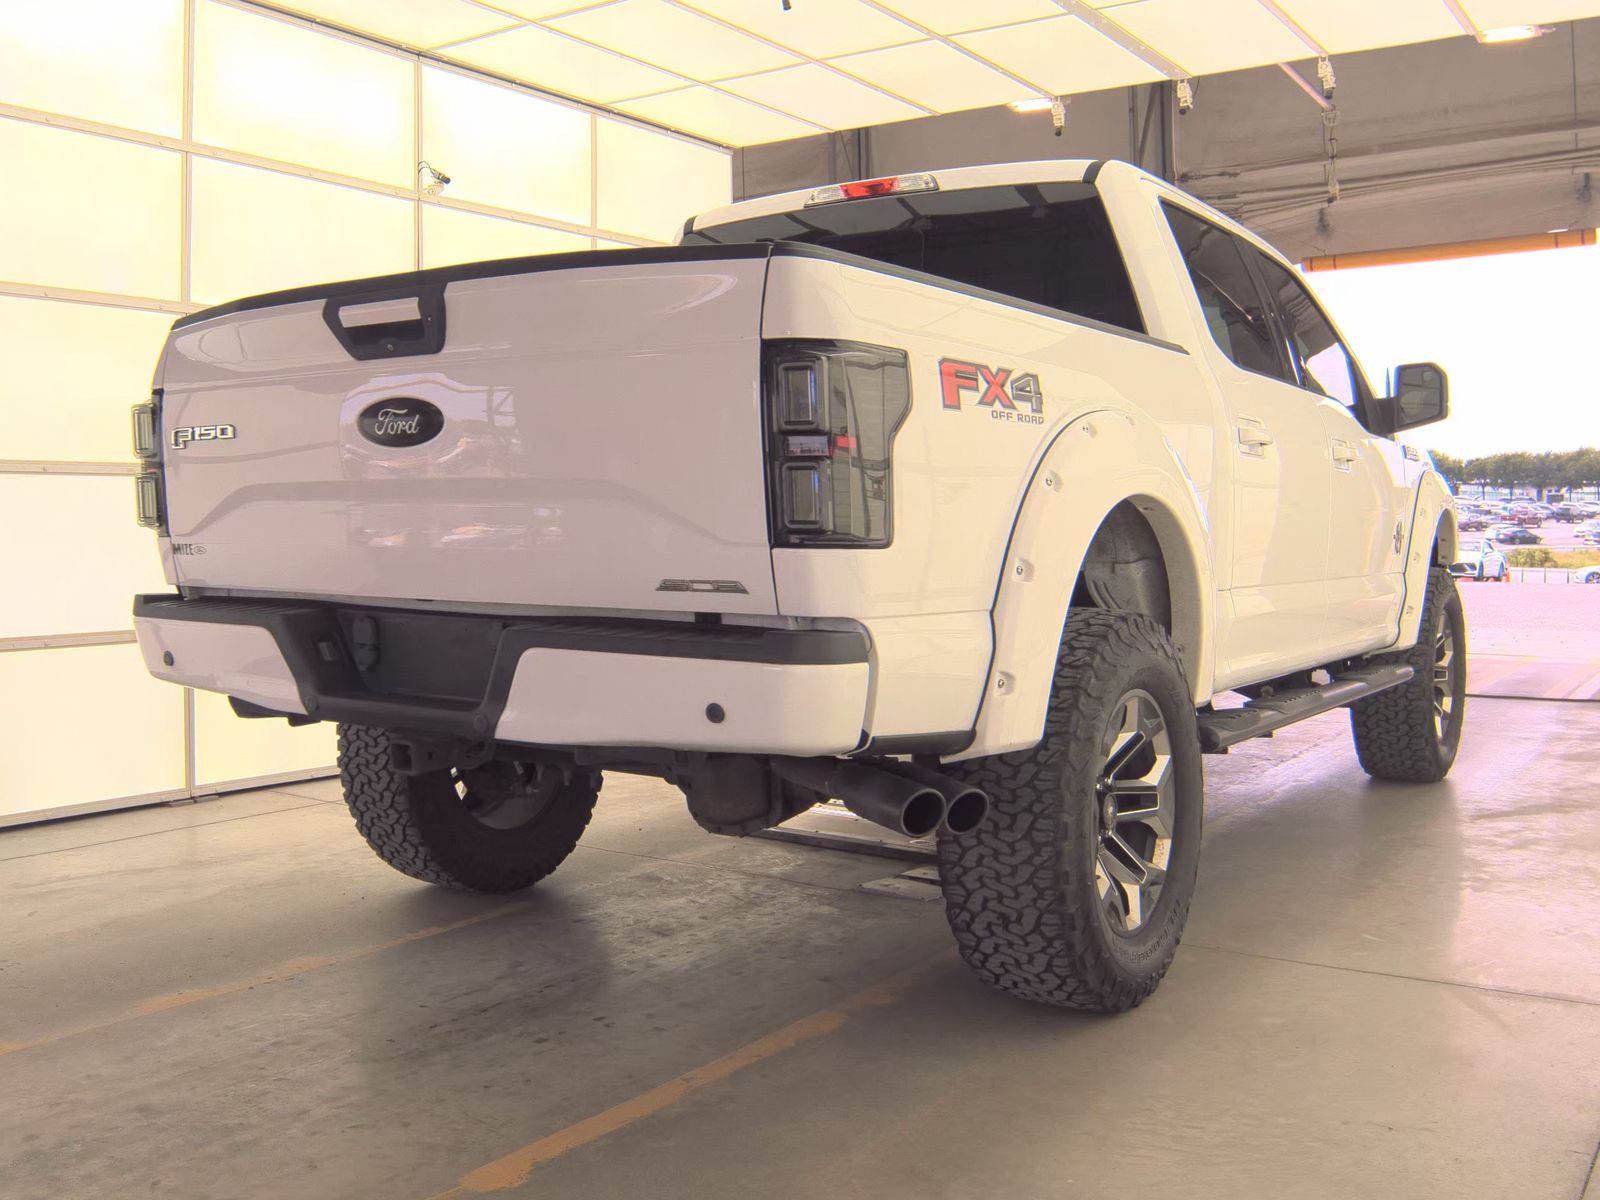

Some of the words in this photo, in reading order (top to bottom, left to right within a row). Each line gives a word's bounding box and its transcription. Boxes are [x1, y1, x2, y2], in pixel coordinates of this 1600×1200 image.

[938, 358, 1043, 414] FX4
[374, 408, 419, 435] Ford
[991, 410, 1013, 421] OFF
[1017, 413, 1044, 424] ROAD
